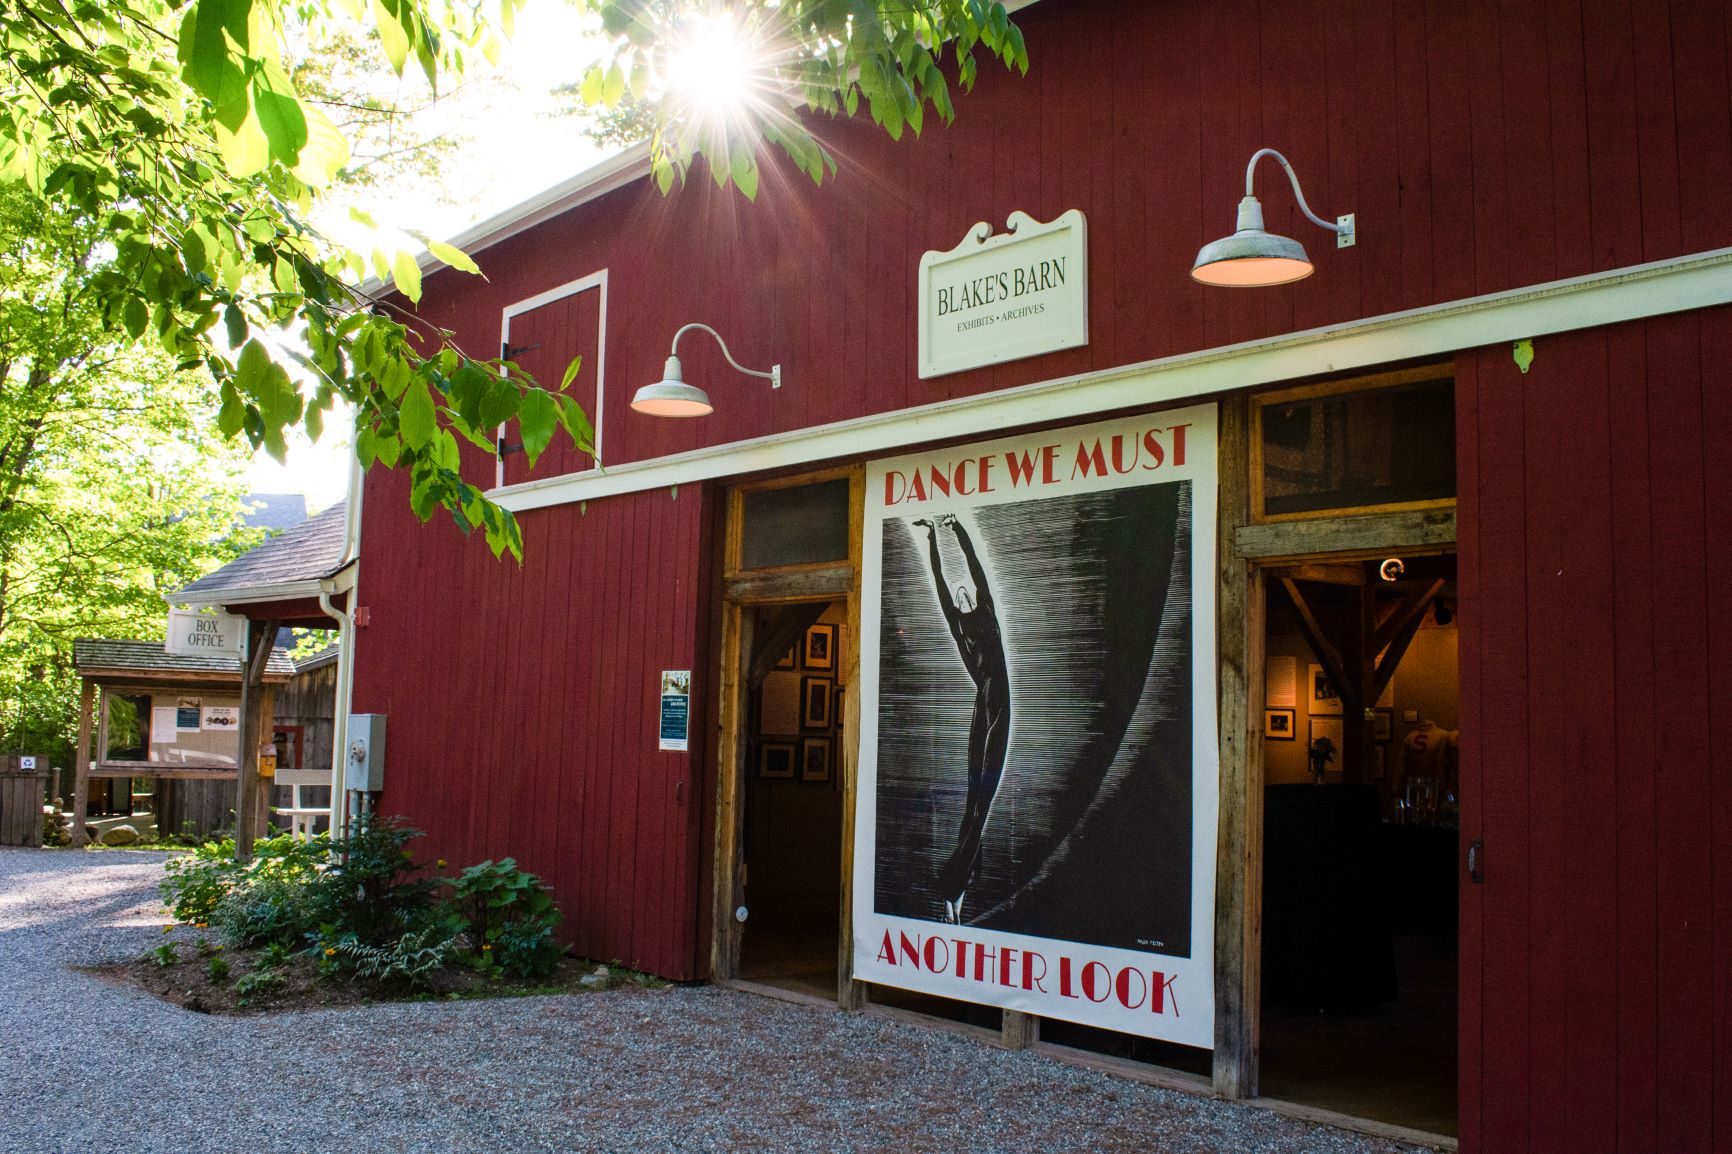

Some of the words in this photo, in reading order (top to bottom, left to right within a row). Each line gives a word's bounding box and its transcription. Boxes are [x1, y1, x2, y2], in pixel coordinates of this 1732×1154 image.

[937, 271, 1008, 316] BLAKE'S
[1013, 256, 1066, 297] BARN
[957, 314, 994, 333] EXHIBITS
[1001, 303, 1045, 322] ARCHIVES
[884, 455, 996, 506] DANCE
[1005, 444, 1061, 489] WE
[1071, 423, 1193, 481] MUST
[187, 633, 225, 647] OFFICE
[196, 619, 219, 633] BOX
[1413, 734, 1428, 754] S
[876, 928, 1048, 994] ANOTHER
[1060, 957, 1180, 1018] LOOK
